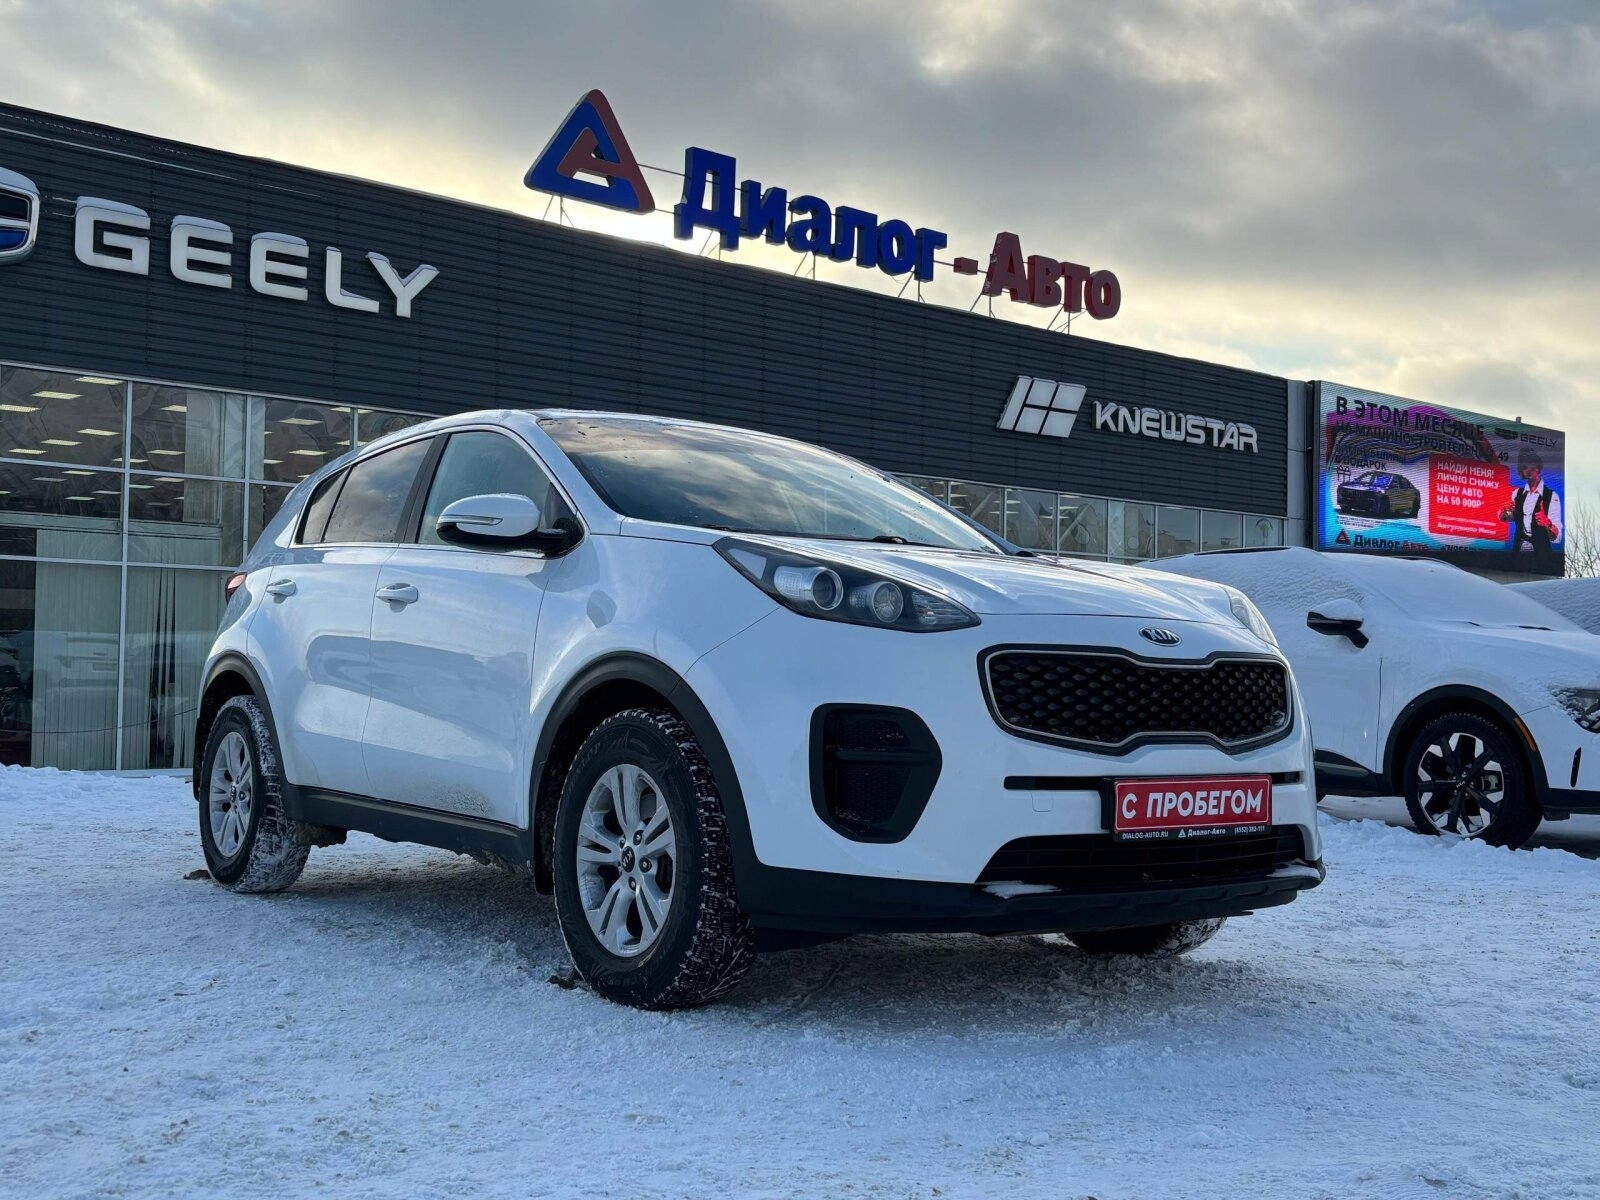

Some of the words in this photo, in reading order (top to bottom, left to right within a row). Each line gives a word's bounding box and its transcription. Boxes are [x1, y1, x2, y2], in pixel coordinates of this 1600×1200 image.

[74, 197, 440, 318] GEELY
[1336, 396, 1347, 415] В
[1354, 399, 1408, 426] ЭТОМ
[1093, 401, 1258, 453] KNEWSTAR
[1520, 433, 1557, 447] GEELY
[1437, 461, 1468, 475] НАЙДИ
[1469, 467, 1495, 478] МЕНЯ!
[1437, 472, 1467, 484] ЛИЧНО
[1469, 477, 1499, 489] СНИЖУ
[1437, 483, 1460, 494] ЦЕНУ
[1462, 487, 1483, 498] АВТО
[1437, 494, 1449, 504] НА
[1451, 496, 1461, 506] 50
[1354, 534, 1400, 549] Диалог
[1122, 793, 1137, 819] С
[1146, 788, 1263, 818] ПРОБЕГОМ
[1122, 831, 1169, 839] DIALOG-AUTO.RU
[1187, 828, 1226, 838] Диалог-Авто
